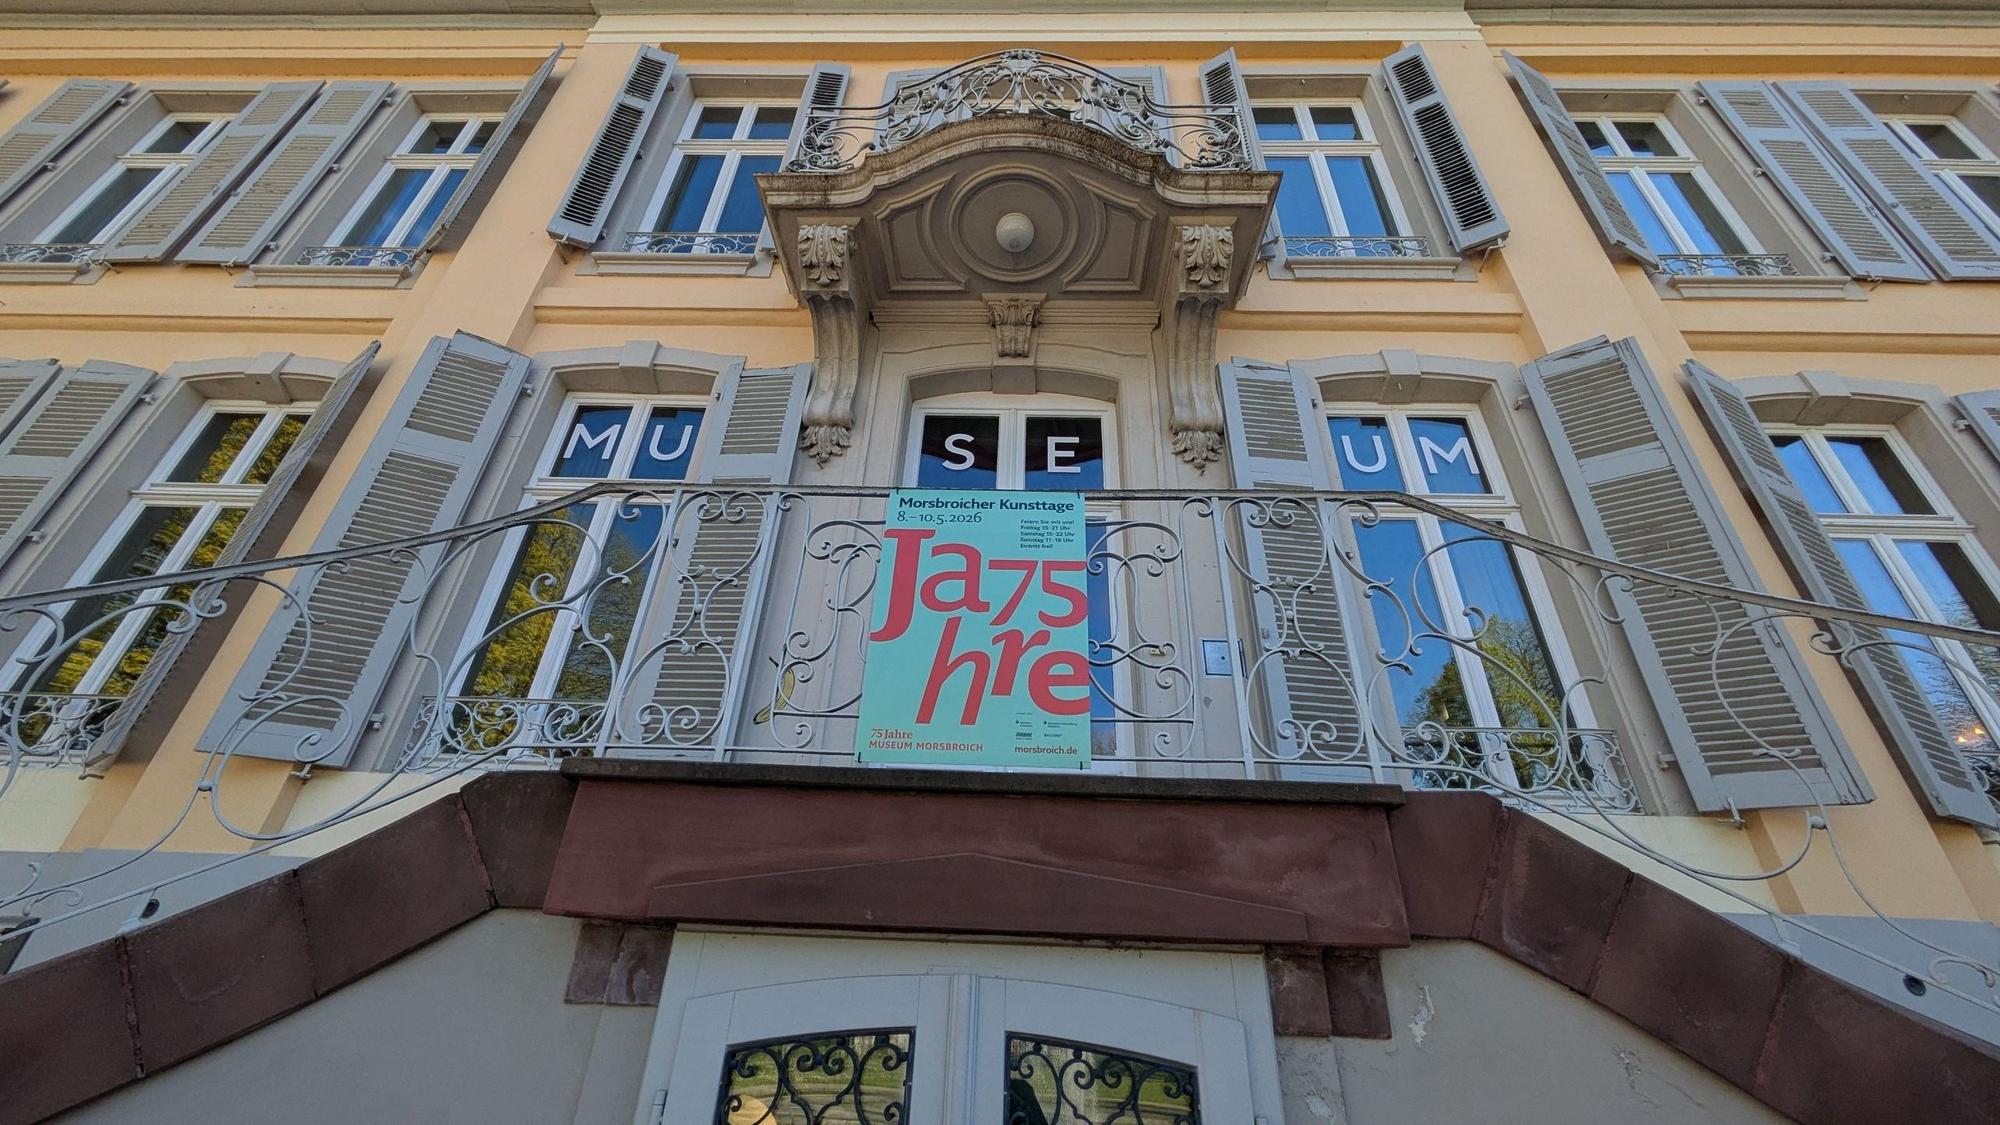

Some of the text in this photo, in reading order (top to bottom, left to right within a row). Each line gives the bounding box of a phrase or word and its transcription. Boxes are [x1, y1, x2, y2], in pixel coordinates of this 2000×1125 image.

[898, 497, 1075, 513] Morsbroicher Kunsttage
[870, 728, 912, 739] 75 Jahre
[868, 740, 983, 752] MUSEUM MORSBROICH
[1014, 745, 1078, 755] morsbroich.de
